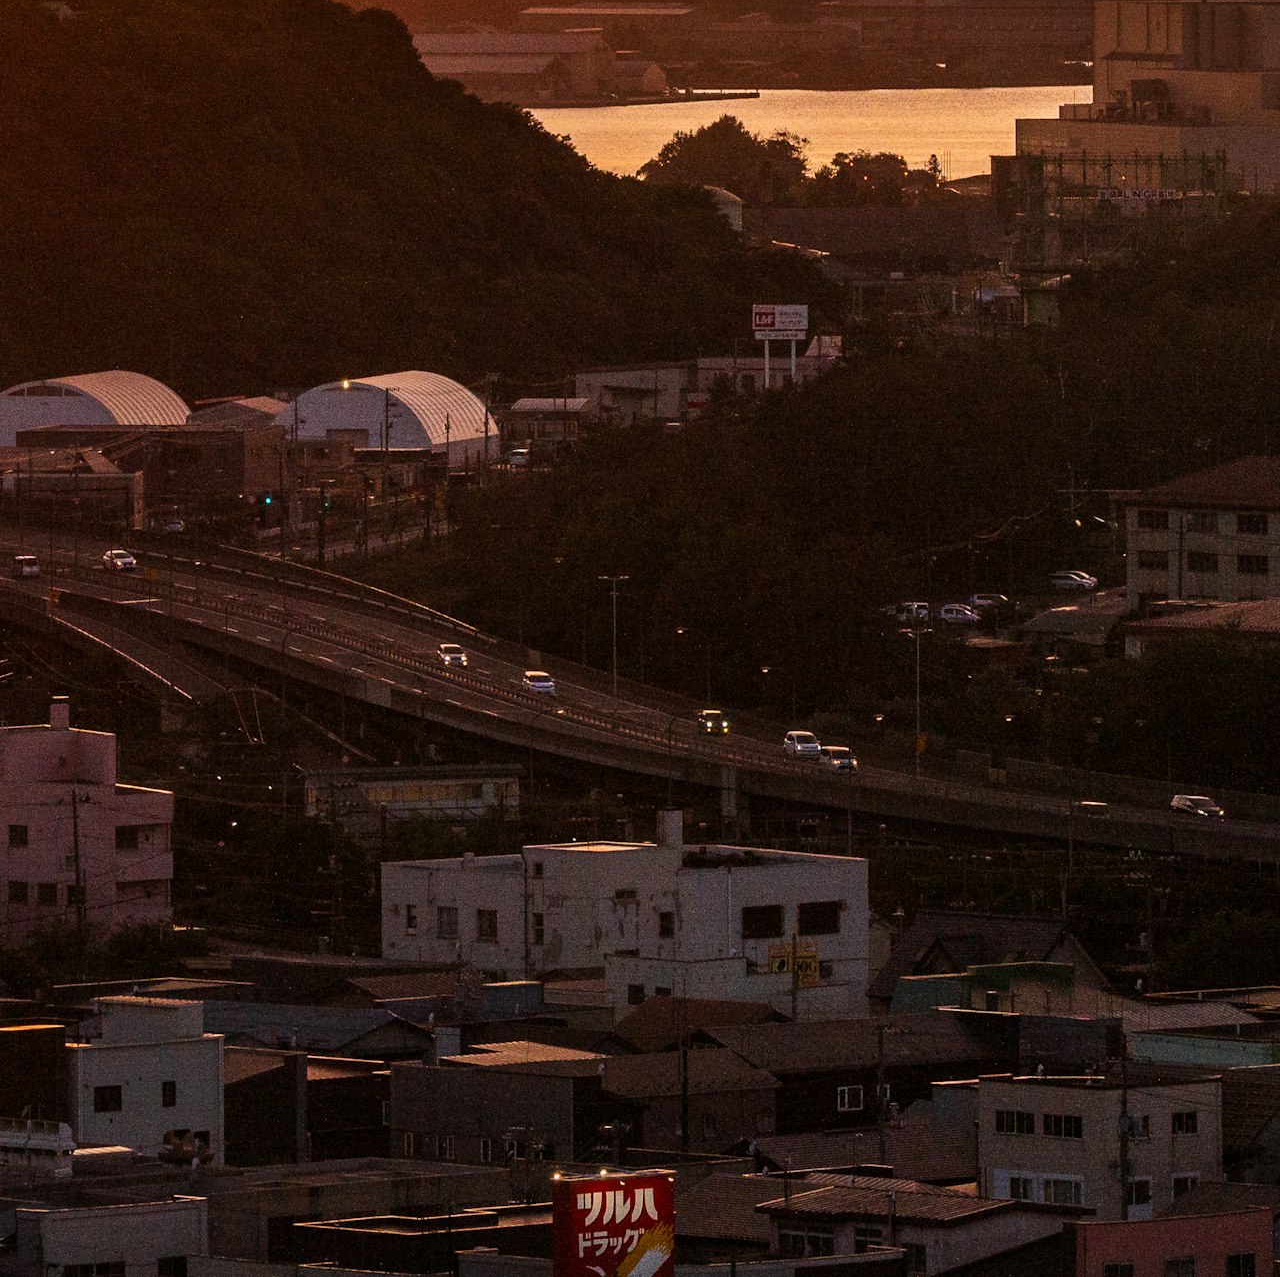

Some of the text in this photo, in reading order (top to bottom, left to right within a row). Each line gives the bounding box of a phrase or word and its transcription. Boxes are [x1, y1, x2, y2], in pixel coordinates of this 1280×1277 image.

[577, 1188, 658, 1227] ツルハ
[578, 1228, 645, 1258] ドラッグ
